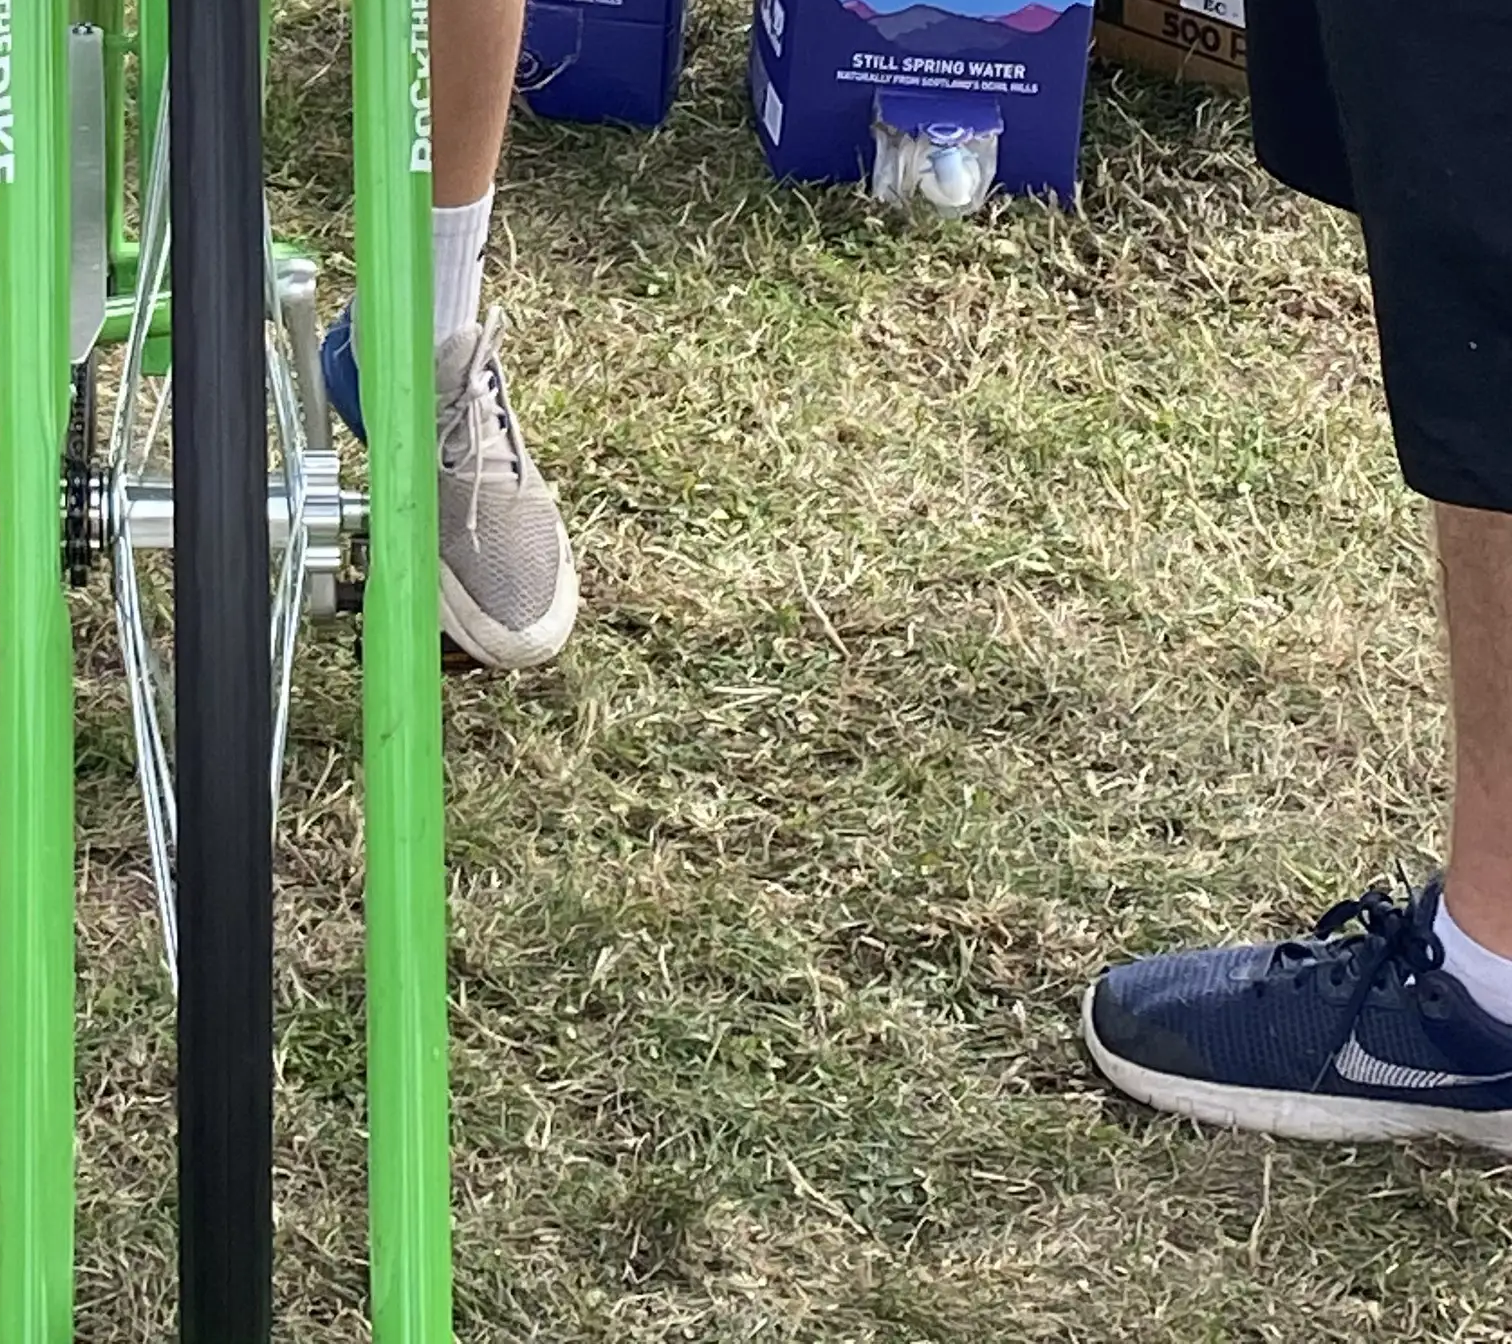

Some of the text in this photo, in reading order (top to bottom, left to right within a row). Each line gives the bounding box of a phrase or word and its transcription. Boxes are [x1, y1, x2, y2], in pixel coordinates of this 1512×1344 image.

[1162, 11, 1221, 54] 500
[851, 52, 1026, 80] STILL SPRING WATER
